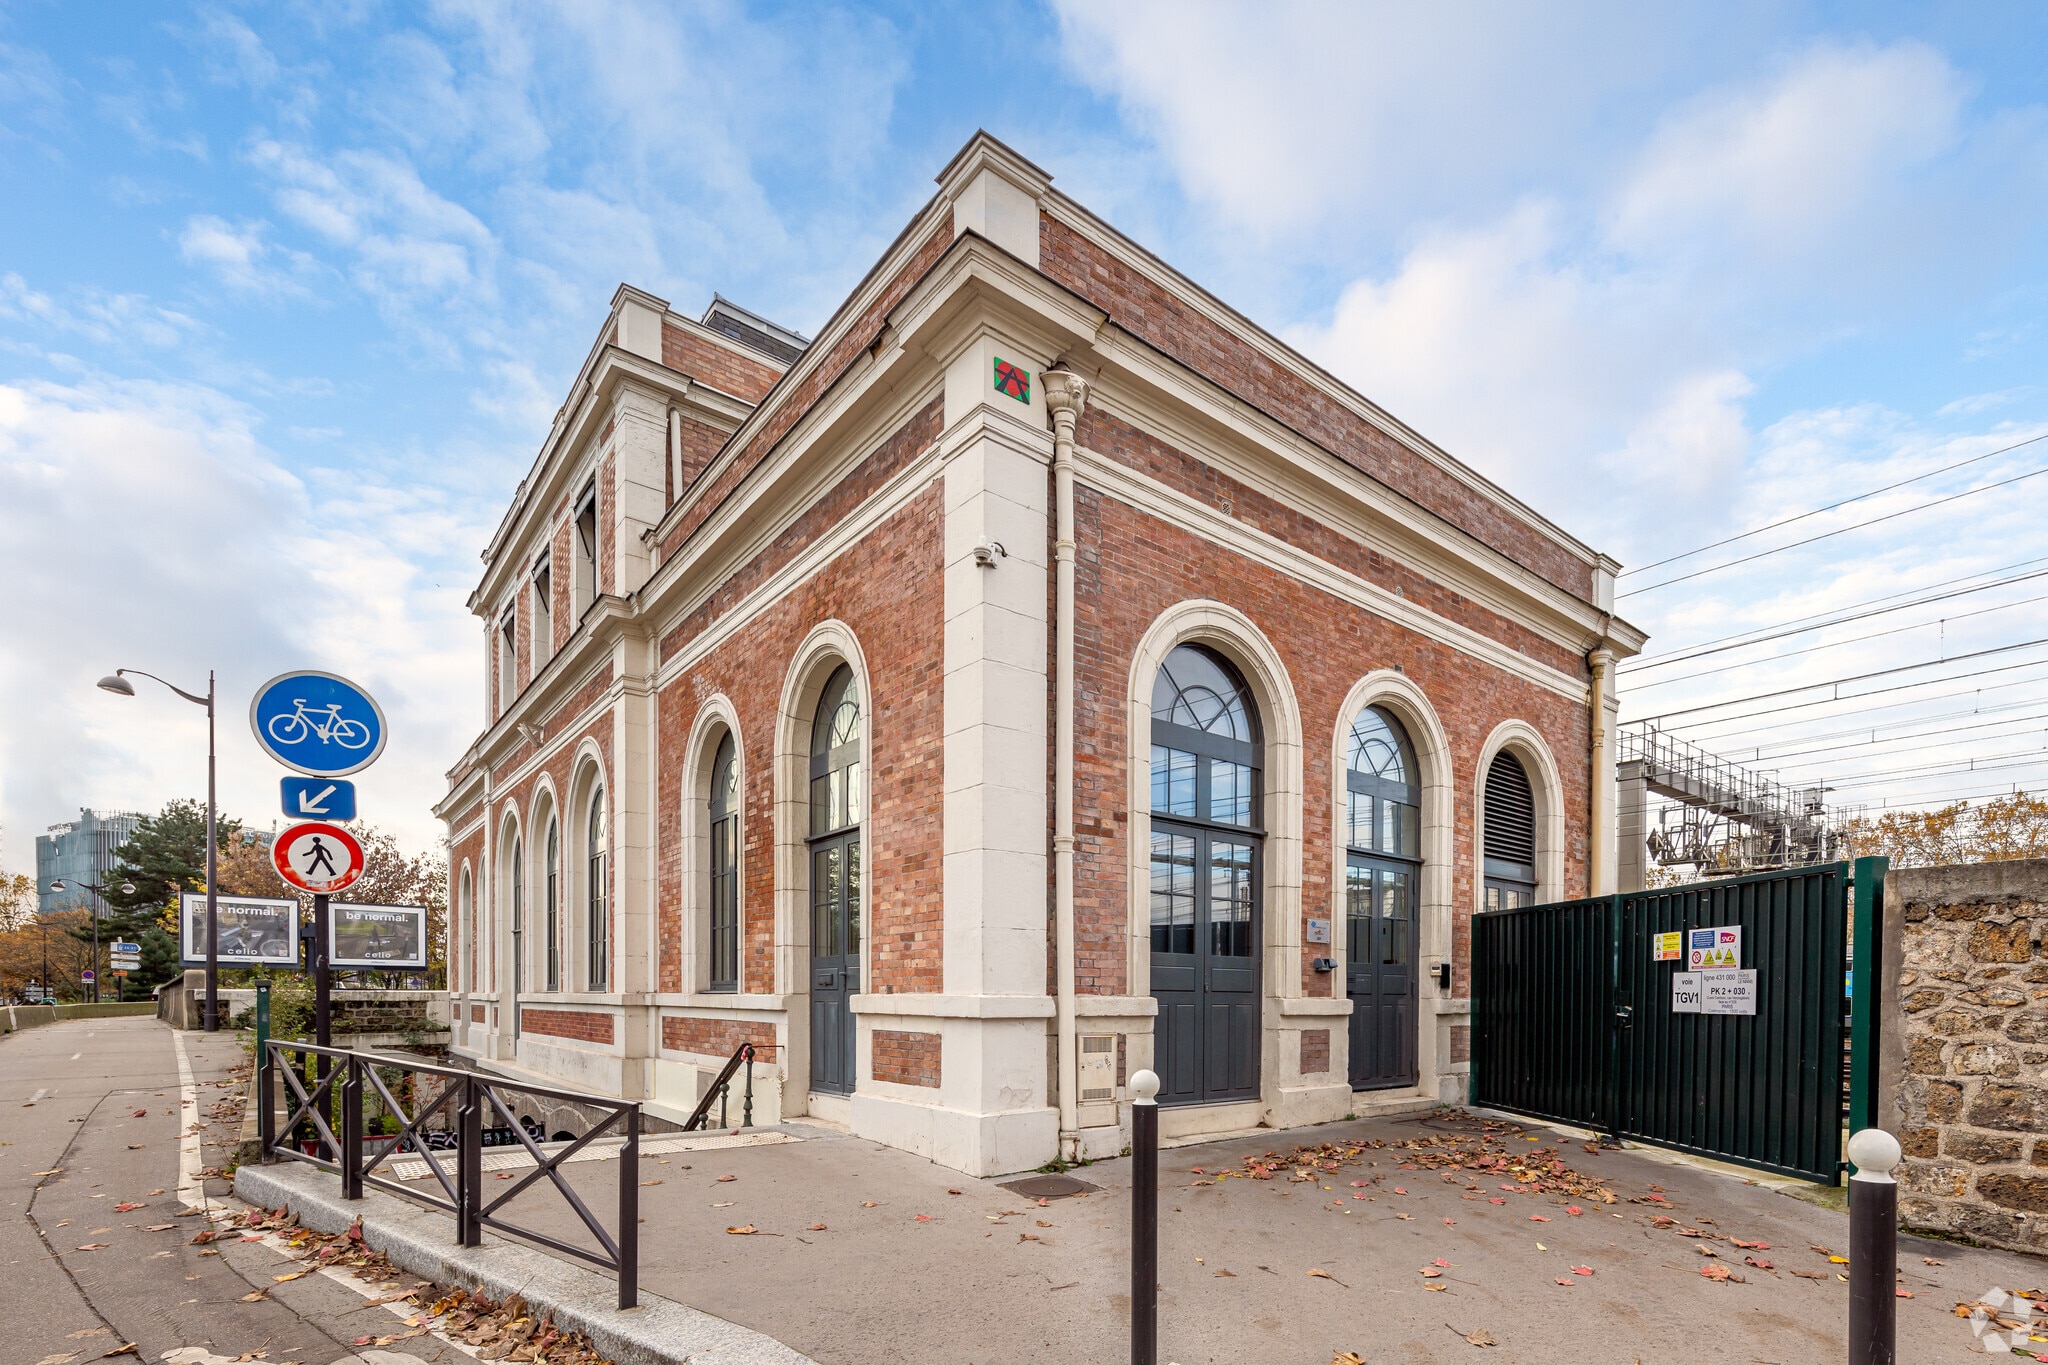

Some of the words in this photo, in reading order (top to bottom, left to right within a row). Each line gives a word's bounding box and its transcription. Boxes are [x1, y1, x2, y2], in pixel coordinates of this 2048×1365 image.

[227, 906, 279, 916] normal.
[346, 911, 361, 919] be
[364, 913, 409, 922] normal.
[1721, 935, 1735, 943] SNCF
[1675, 992, 1699, 1004] TGV1
